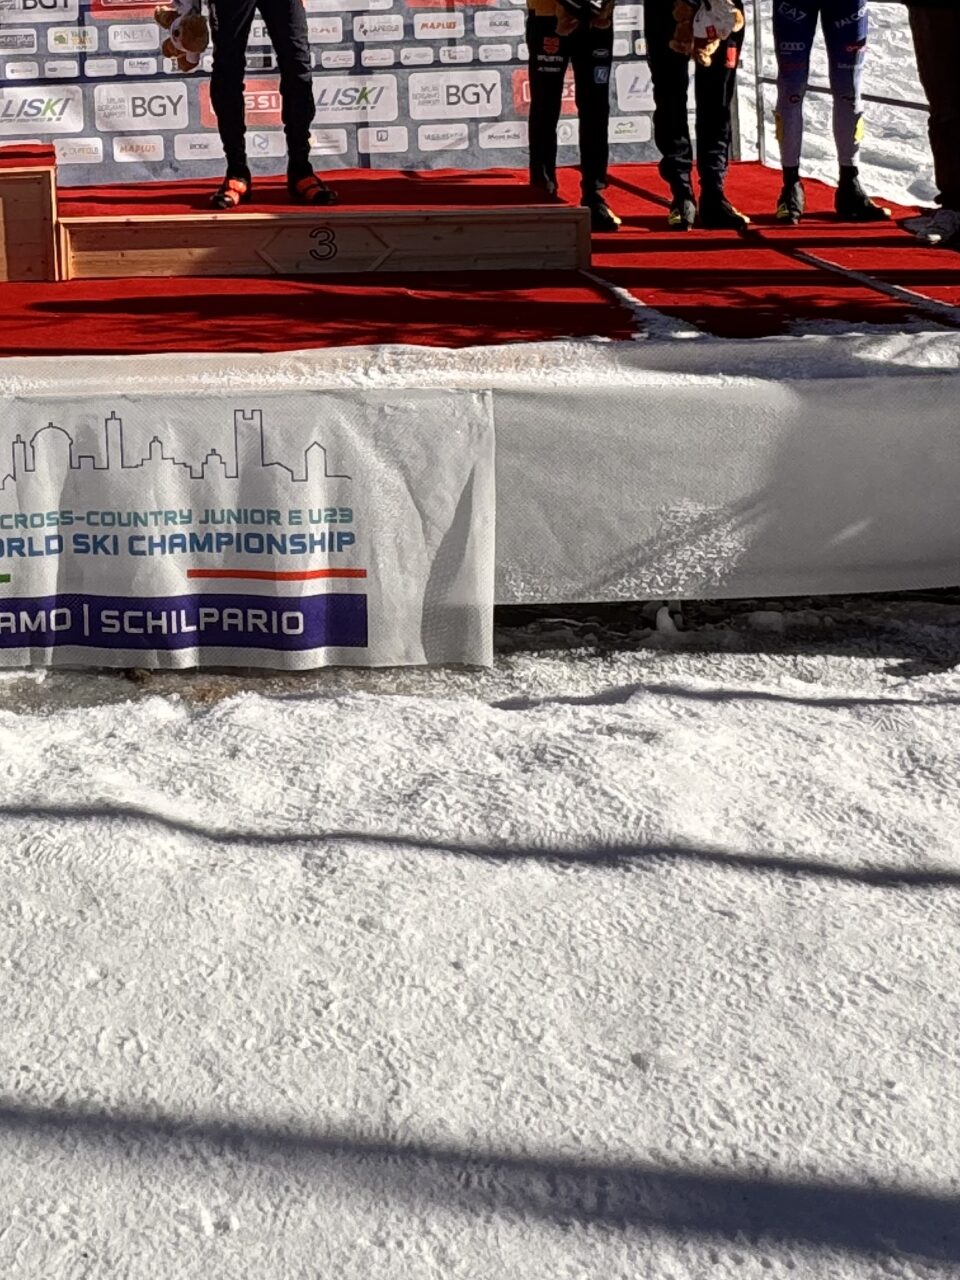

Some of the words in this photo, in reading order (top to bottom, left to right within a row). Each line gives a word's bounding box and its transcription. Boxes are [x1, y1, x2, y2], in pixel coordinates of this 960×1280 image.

[113, 31, 153, 40] PINETA
[132, 94, 183, 118] BGY
[244, 93, 278, 111] SSI
[315, 86, 385, 106] LISKI
[446, 83, 497, 106] BGY
[0, 98, 72, 118] LISKI
[308, 226, 338, 261] 3
[0, 507, 192, 531] CROSS-COUNTRY
[198, 508, 282, 526] JUNIOR
[288, 508, 303, 524] E
[308, 507, 355, 524] U23
[72, 534, 120, 556] SKI
[128, 532, 357, 558] CHAMPIONSHIP
[101, 607, 305, 636] SCHILPARIO
